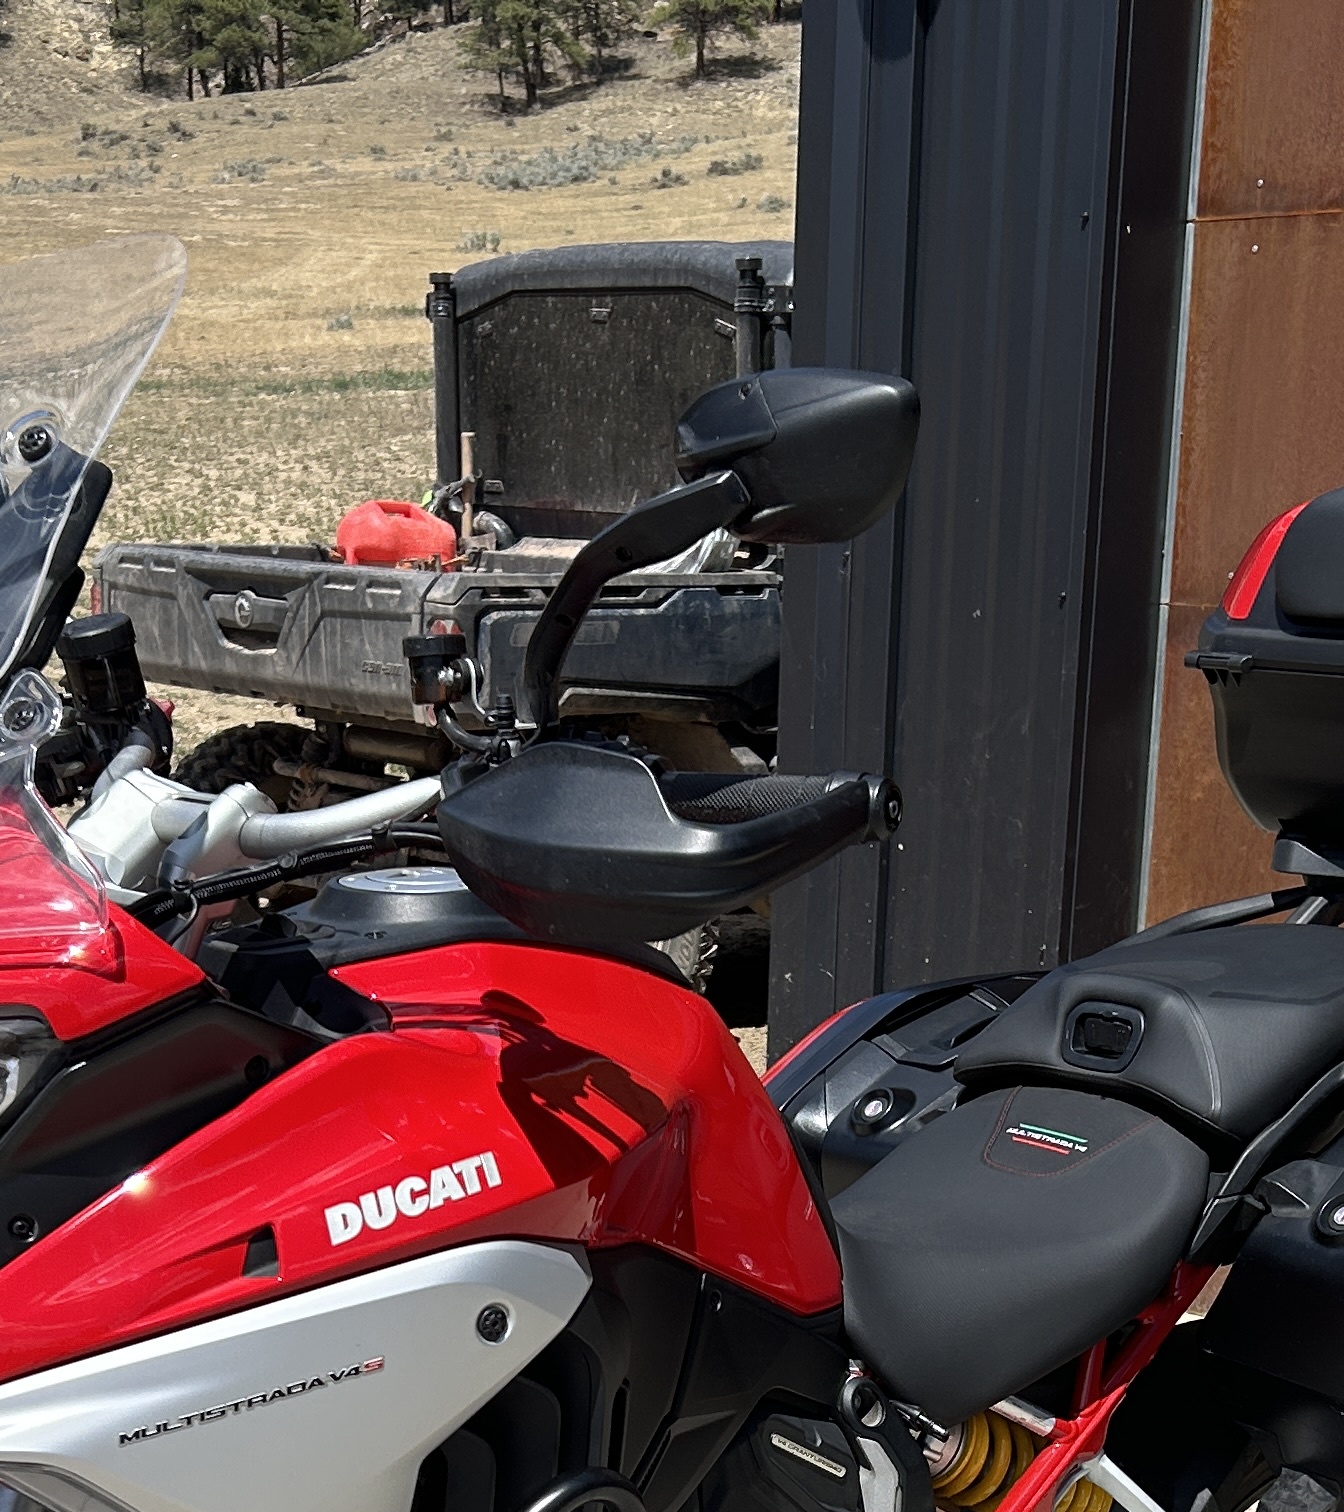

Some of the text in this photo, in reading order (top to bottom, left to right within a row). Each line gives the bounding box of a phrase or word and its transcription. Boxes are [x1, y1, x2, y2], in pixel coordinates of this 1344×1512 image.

[324, 1151, 502, 1246] DUCATI
[119, 1356, 385, 1446] MULTISTRADA V4S
[788, 1443, 843, 1473] GRANTURISMO
